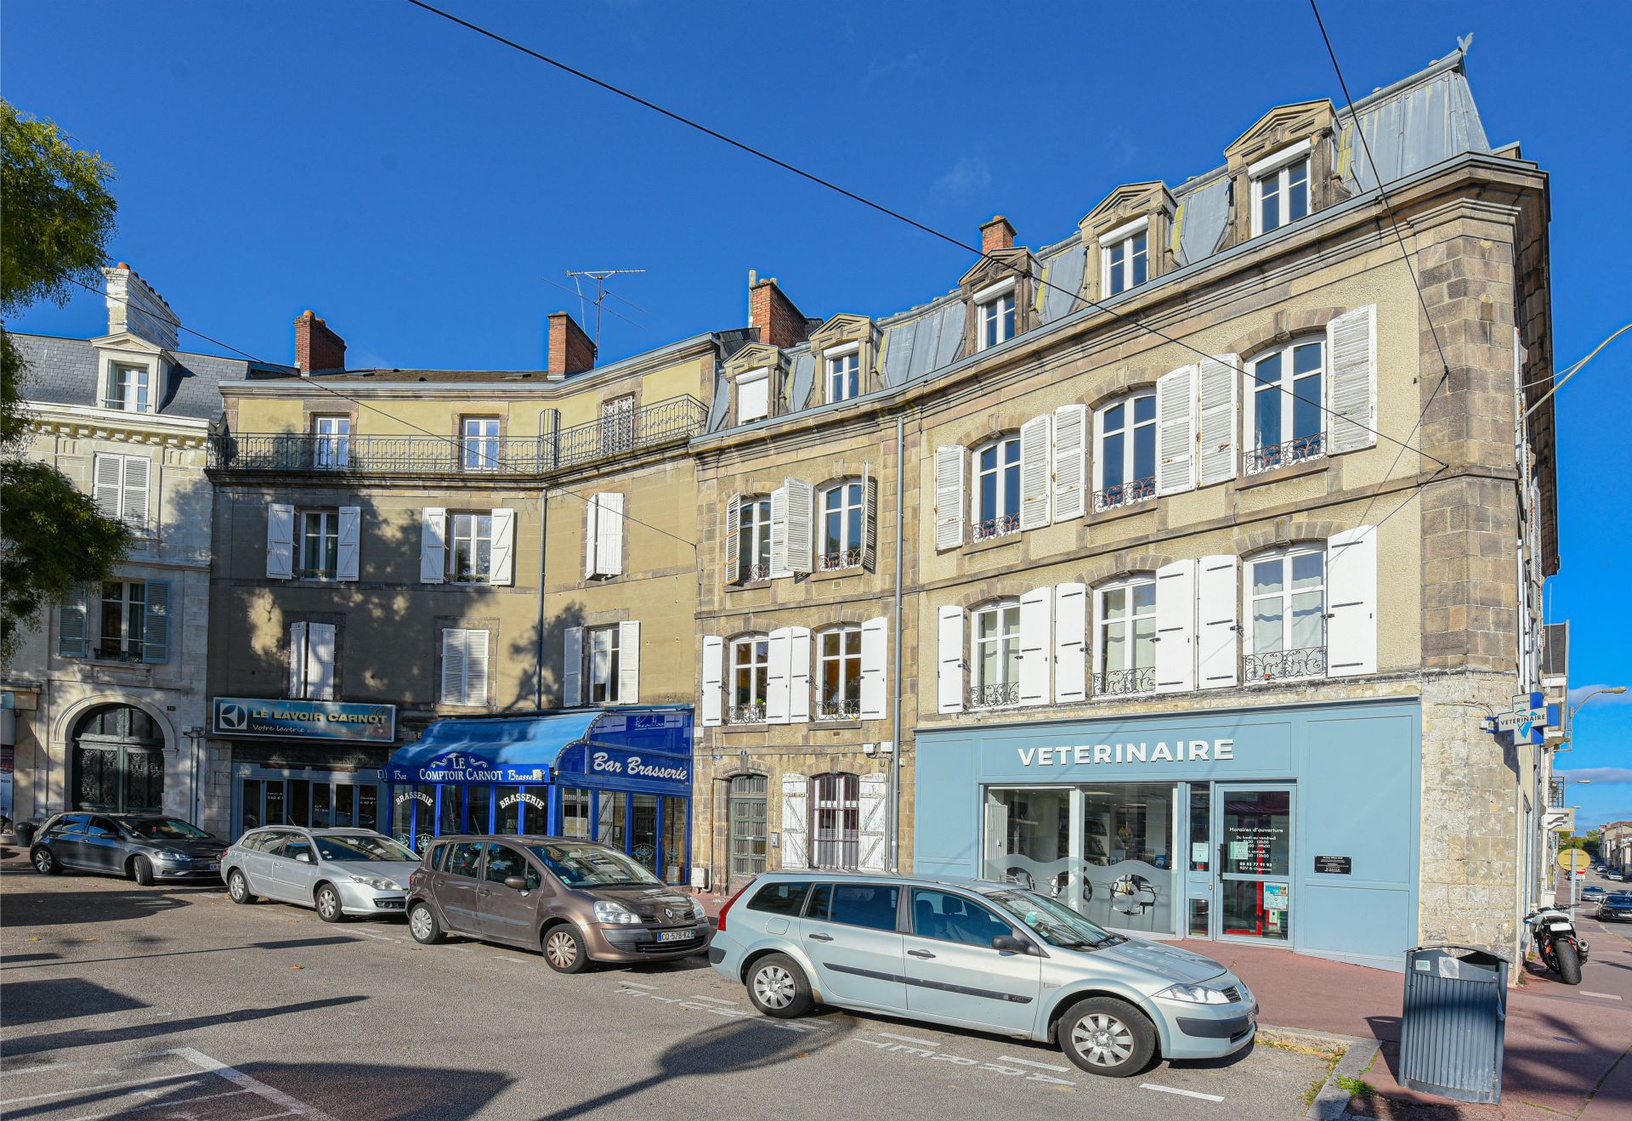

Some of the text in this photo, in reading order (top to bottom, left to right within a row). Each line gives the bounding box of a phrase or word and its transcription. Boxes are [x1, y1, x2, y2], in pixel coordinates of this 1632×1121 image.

[252, 709, 388, 725] LE LAVOIR CARNOT
[1500, 713, 1546, 726] VETERINAIRE
[252, 724, 275, 732] Votre
[276, 725, 305, 734] laverie
[1017, 738, 1235, 767] VETERINAIRE
[452, 757, 466, 769] LE
[592, 751, 689, 780] Bar Brasserie
[393, 770, 407, 780] Bar
[419, 768, 465, 781] COMPTOIR
[466, 768, 503, 781] CARNOT
[395, 790, 434, 807] BRASSERIE
[498, 793, 546, 811] BRASSERIE
